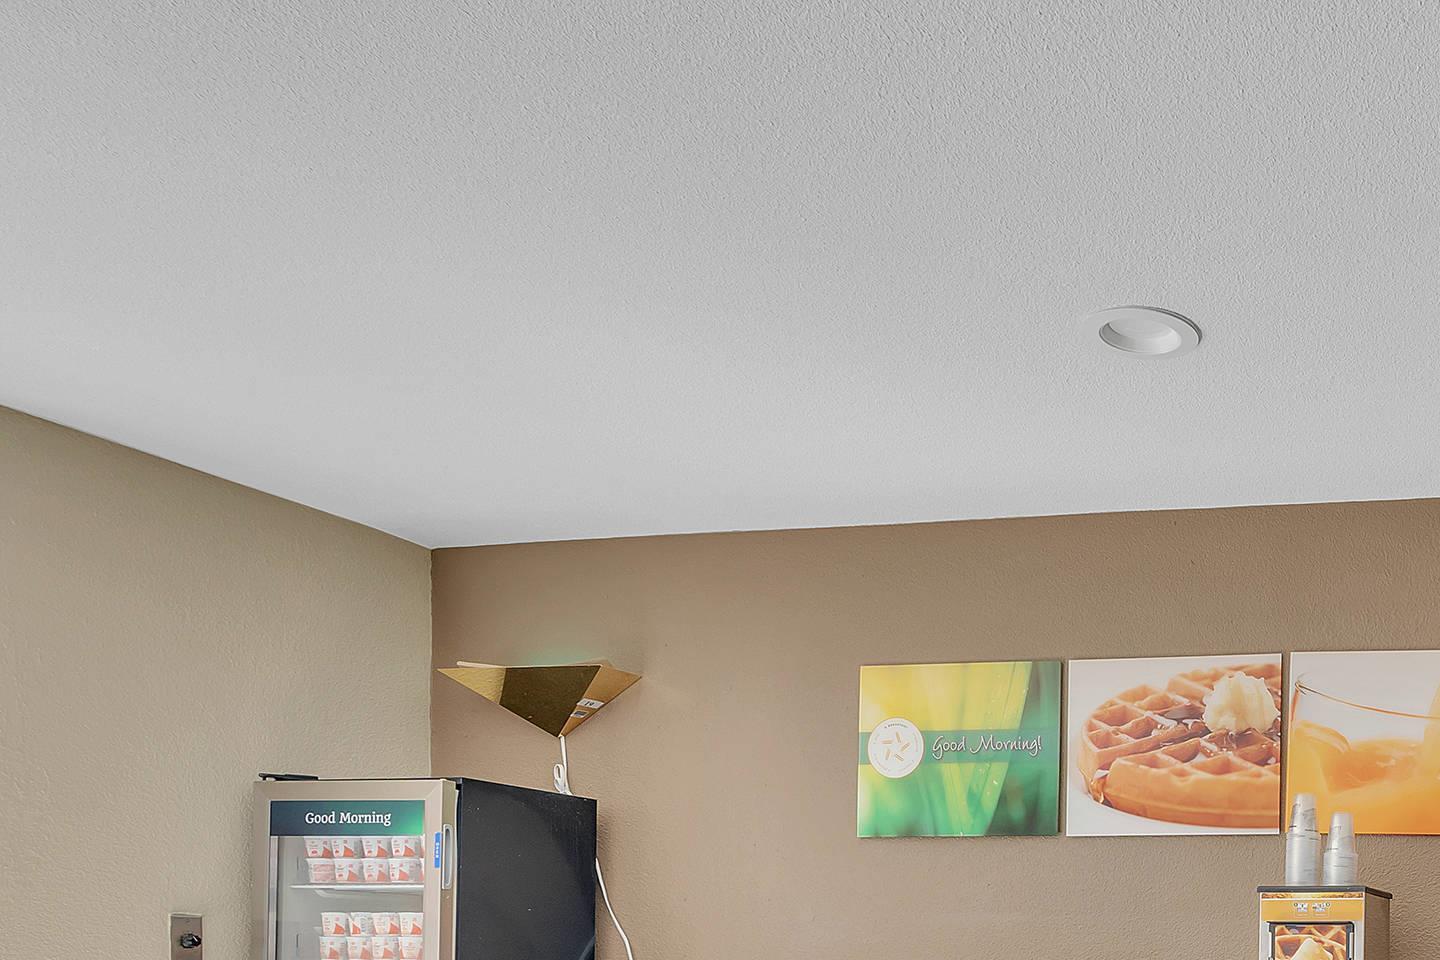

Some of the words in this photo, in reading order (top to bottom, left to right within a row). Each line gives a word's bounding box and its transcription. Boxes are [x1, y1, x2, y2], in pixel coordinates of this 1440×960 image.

[931, 735, 966, 760] Good
[969, 733, 1043, 758] Morning!
[305, 811, 337, 824] Good
[339, 811, 392, 827] Morning
